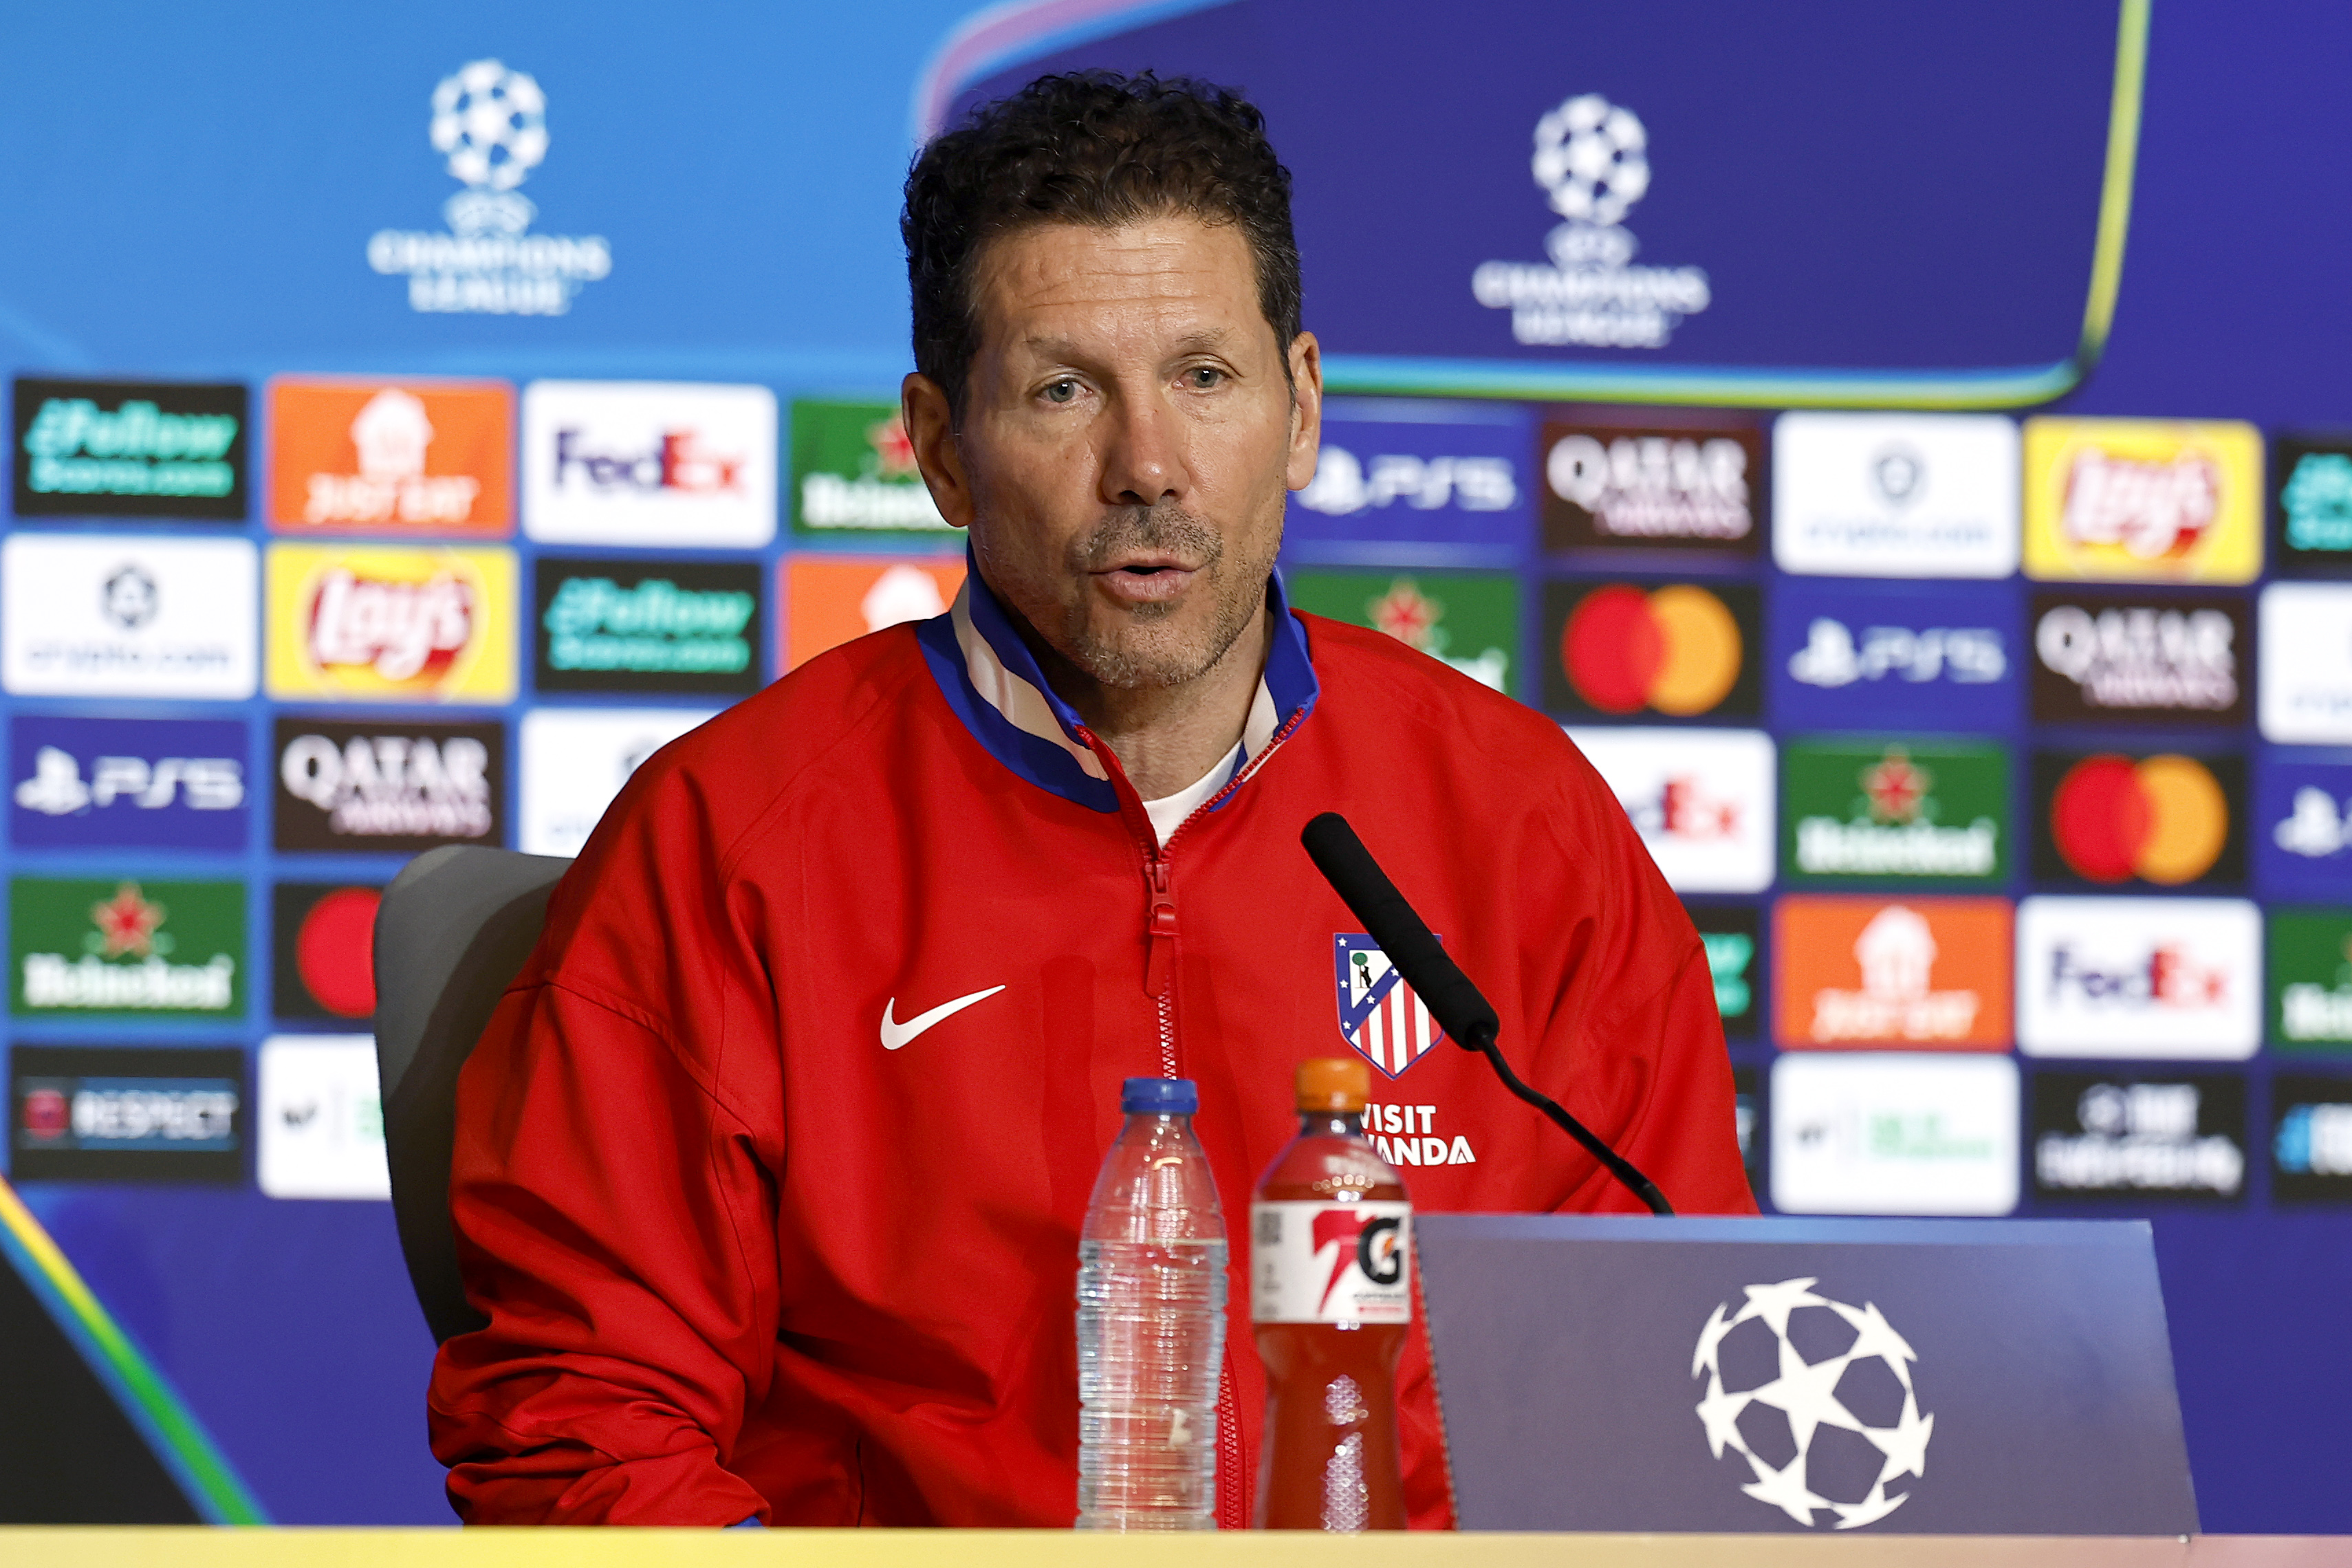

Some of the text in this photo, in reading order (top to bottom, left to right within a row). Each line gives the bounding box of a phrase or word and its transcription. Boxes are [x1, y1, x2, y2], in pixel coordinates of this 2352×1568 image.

[369, 231, 611, 280] CHAMPIONS
[1473, 262, 1710, 314] CHAMPIONS
[555, 428, 744, 494] FedEx
[1367, 455, 1516, 511] PS5
[1547, 435, 1747, 510] QATAR
[802, 473, 957, 530] Heine
[2067, 448, 2216, 559] Lay's
[313, 569, 468, 680] Lay's
[1860, 628, 2007, 682] PS5
[2036, 605, 2234, 682] QATAR
[92, 756, 244, 809] PS5
[282, 734, 489, 809] QATAR
[1628, 774, 1747, 840] dEx
[23, 954, 234, 1008] Heineken
[2047, 942, 2231, 1012] FedEx
[73, 1090, 238, 1139] RESPECT
[1362, 1133, 1477, 1166] ANDA
[1359, 1218, 1400, 1284] G
